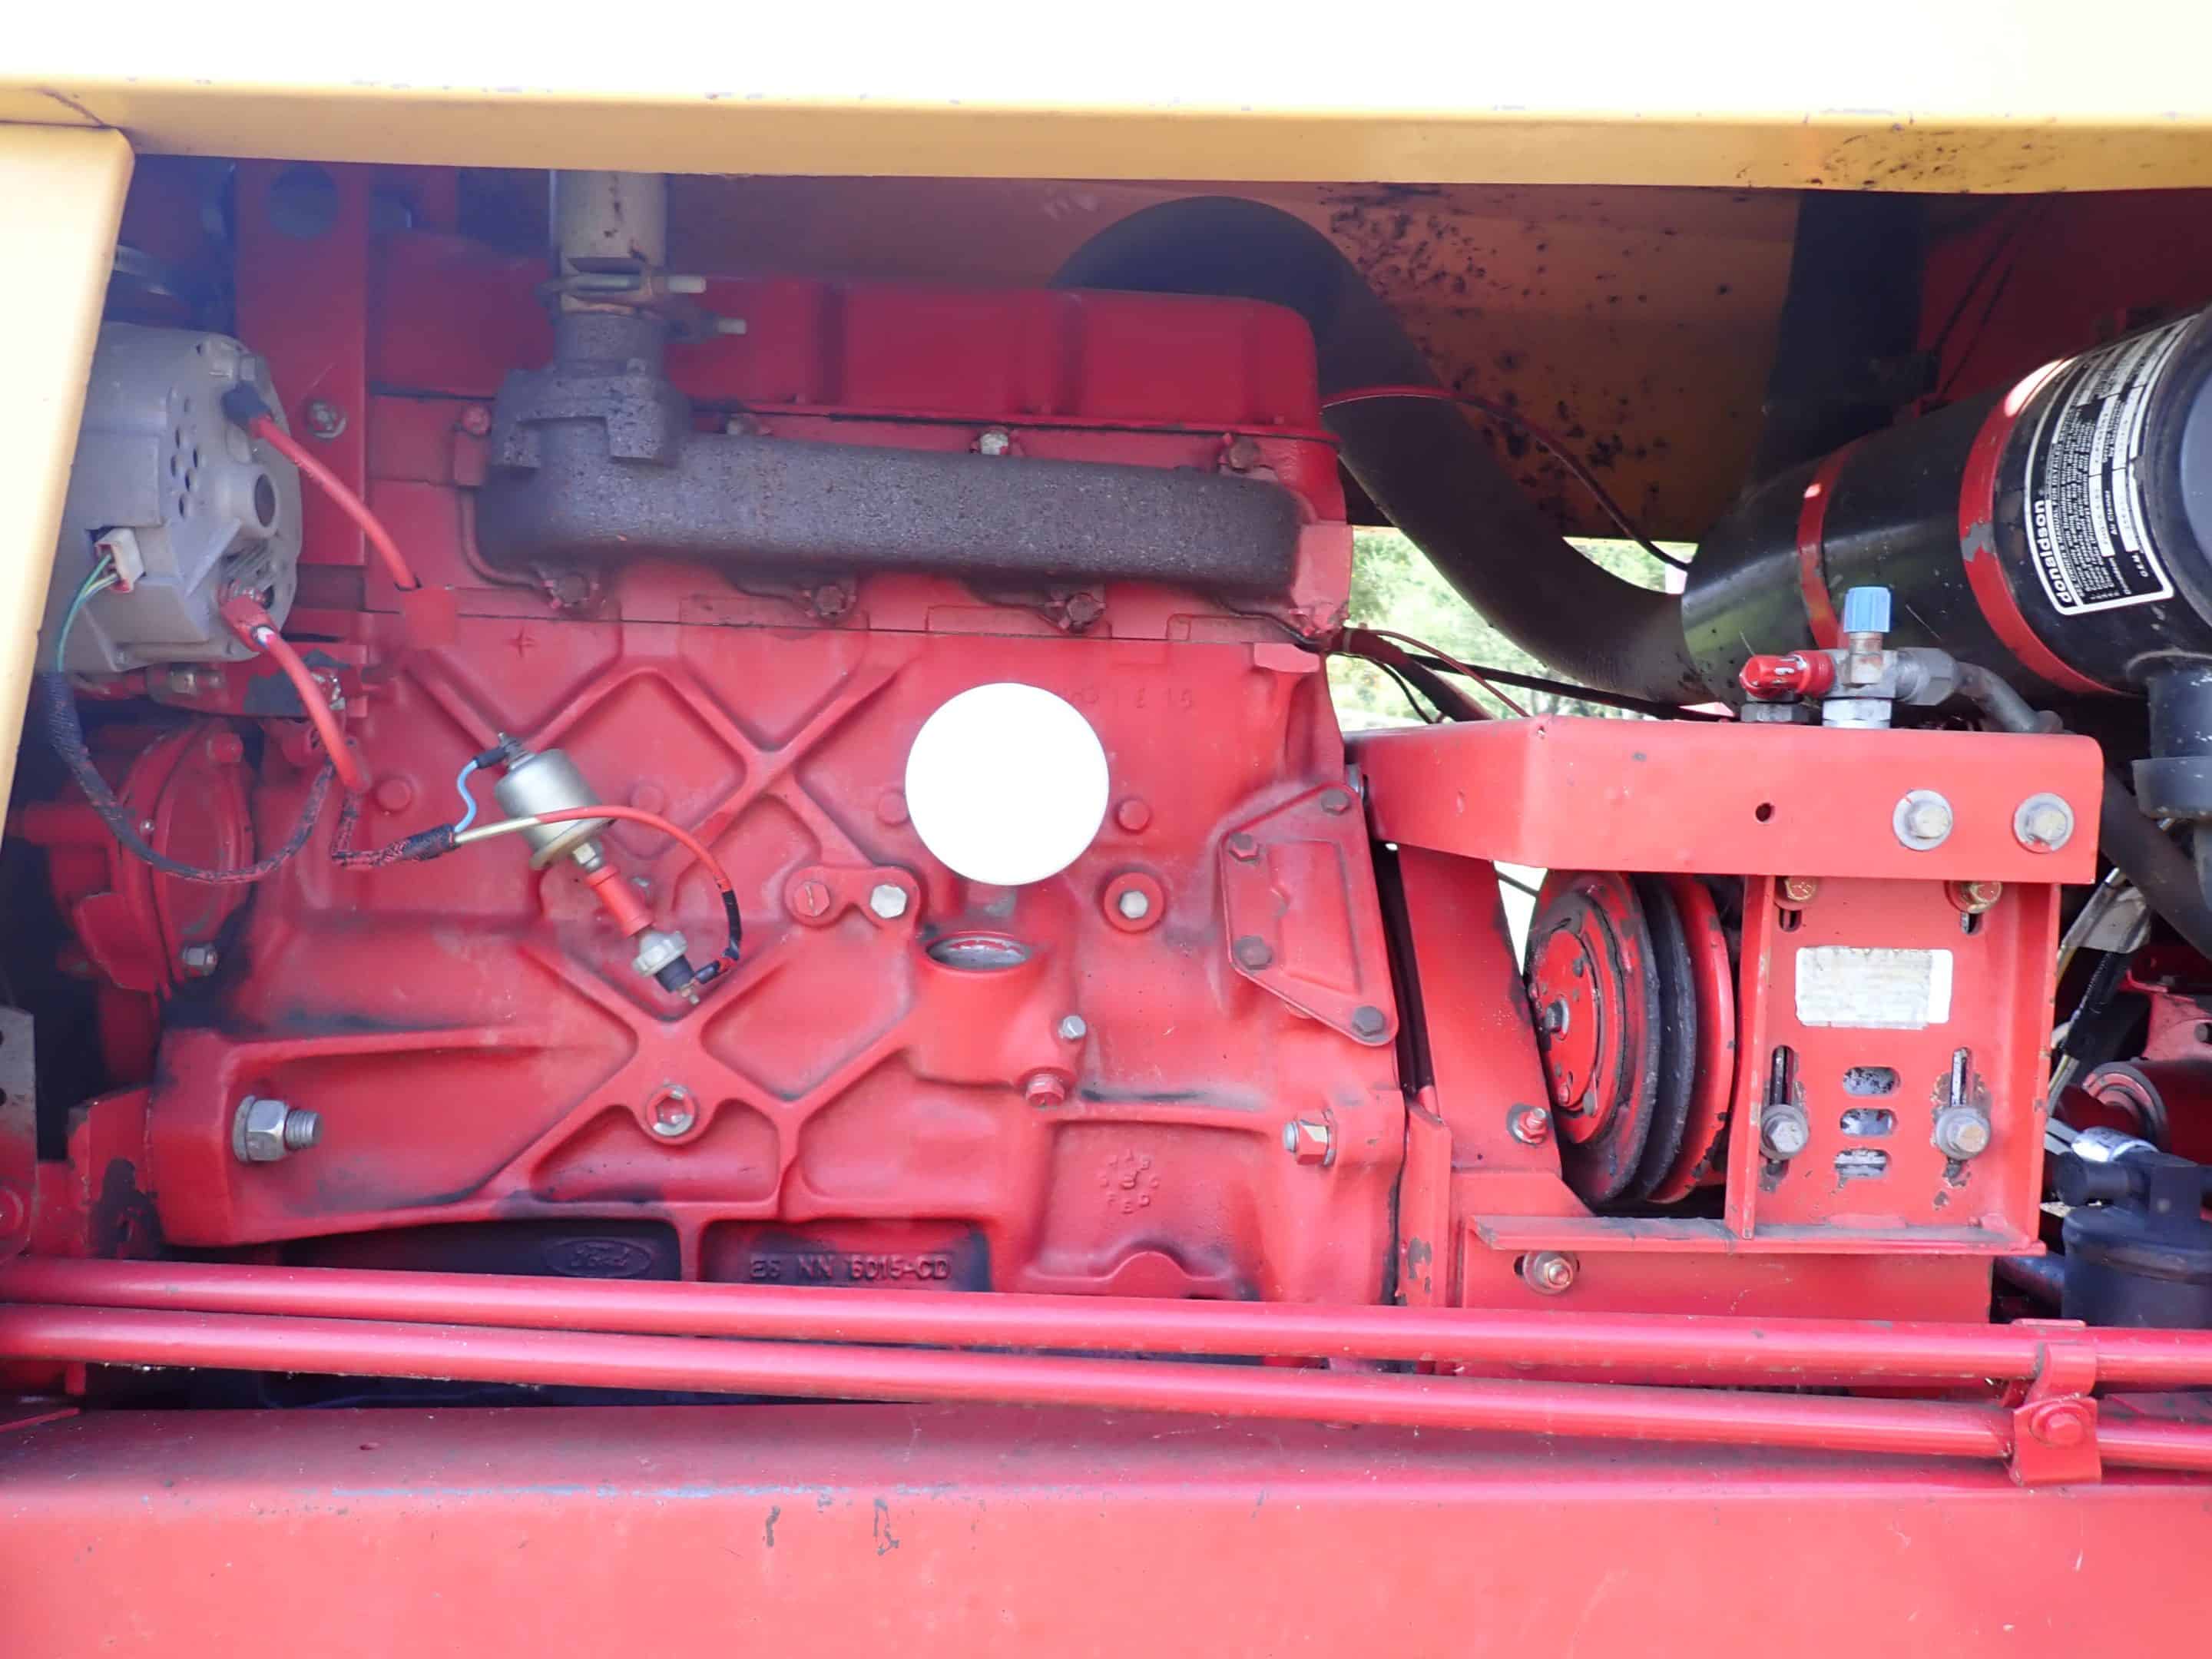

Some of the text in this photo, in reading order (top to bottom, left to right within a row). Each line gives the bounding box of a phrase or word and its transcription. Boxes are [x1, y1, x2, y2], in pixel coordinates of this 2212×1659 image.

[2051, 444, 2061, 485] DETAILED
[2052, 509, 2063, 543] MANUAL
[2104, 490, 2118, 535] Air Cleaner
[2034, 500, 2072, 603] donaldson
[2109, 558, 2131, 595] Donaldson
[796, 1252, 836, 1280] NN
